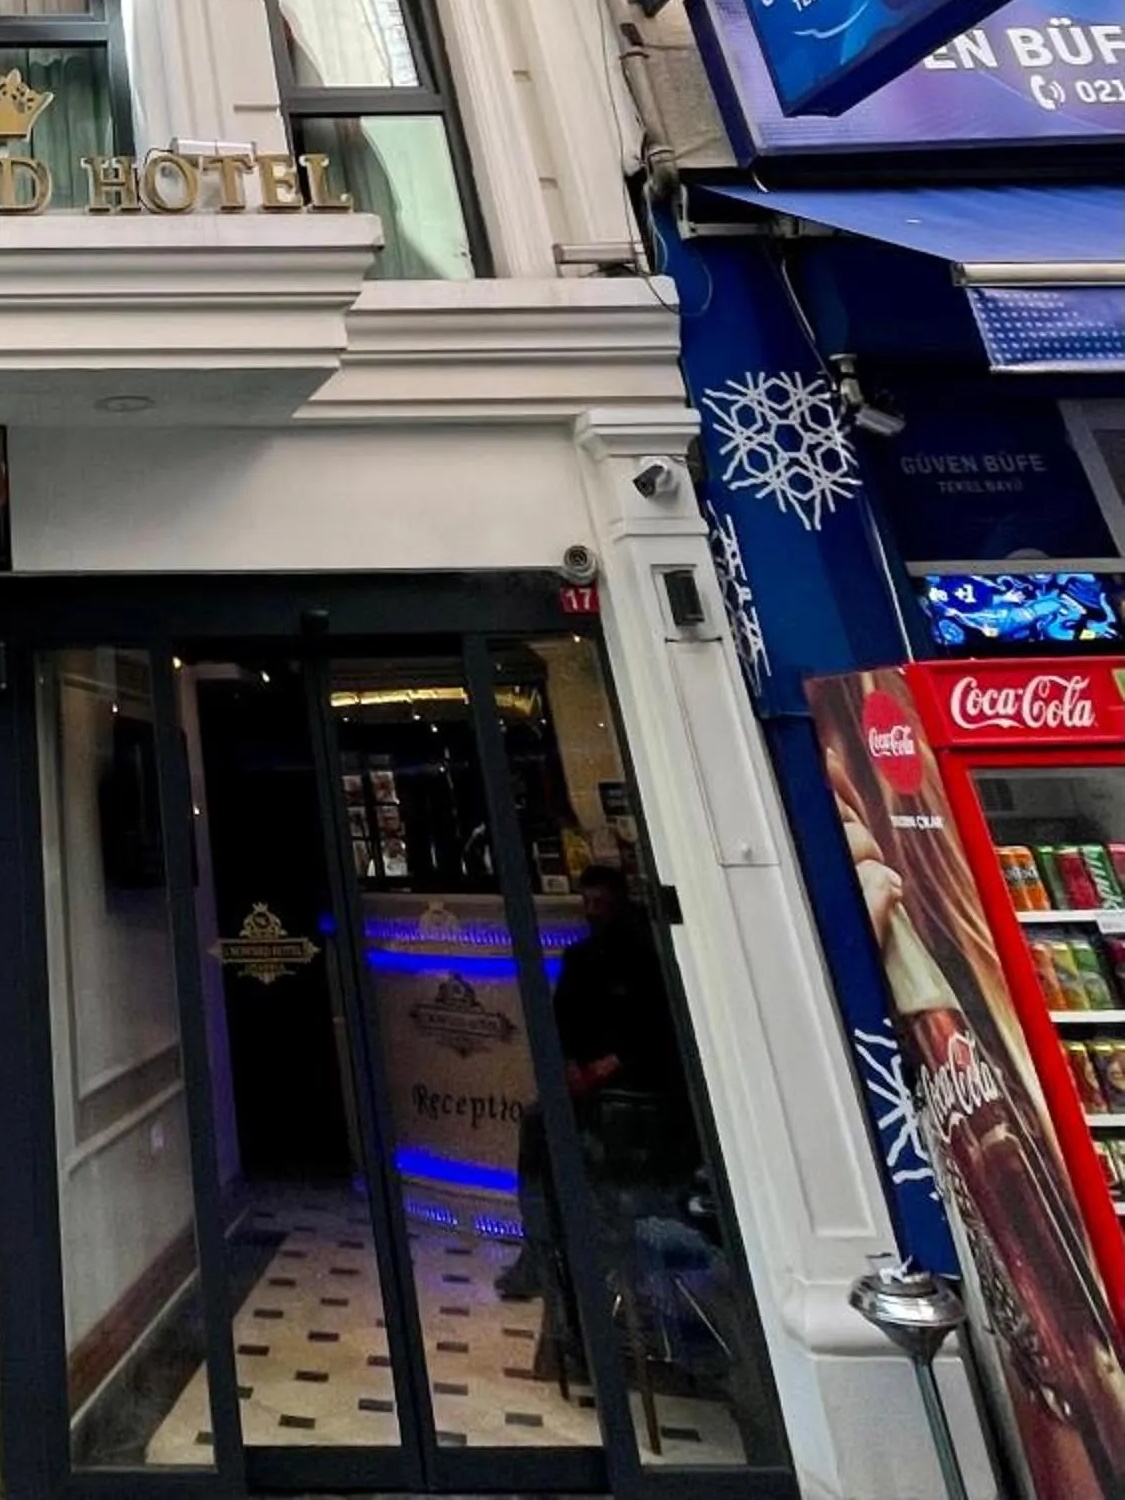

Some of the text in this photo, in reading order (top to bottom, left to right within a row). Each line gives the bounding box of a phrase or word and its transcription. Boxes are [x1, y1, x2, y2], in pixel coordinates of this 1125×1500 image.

[923, 29, 998, 69] EN
[82, 153, 353, 215] HOTEL
[900, 449, 1048, 475] GÜVEN BÜFE
[565, 588, 592, 610] 17
[950, 675, 1096, 730] Coca-Cola
[412, 1083, 524, 1129] Receptio
